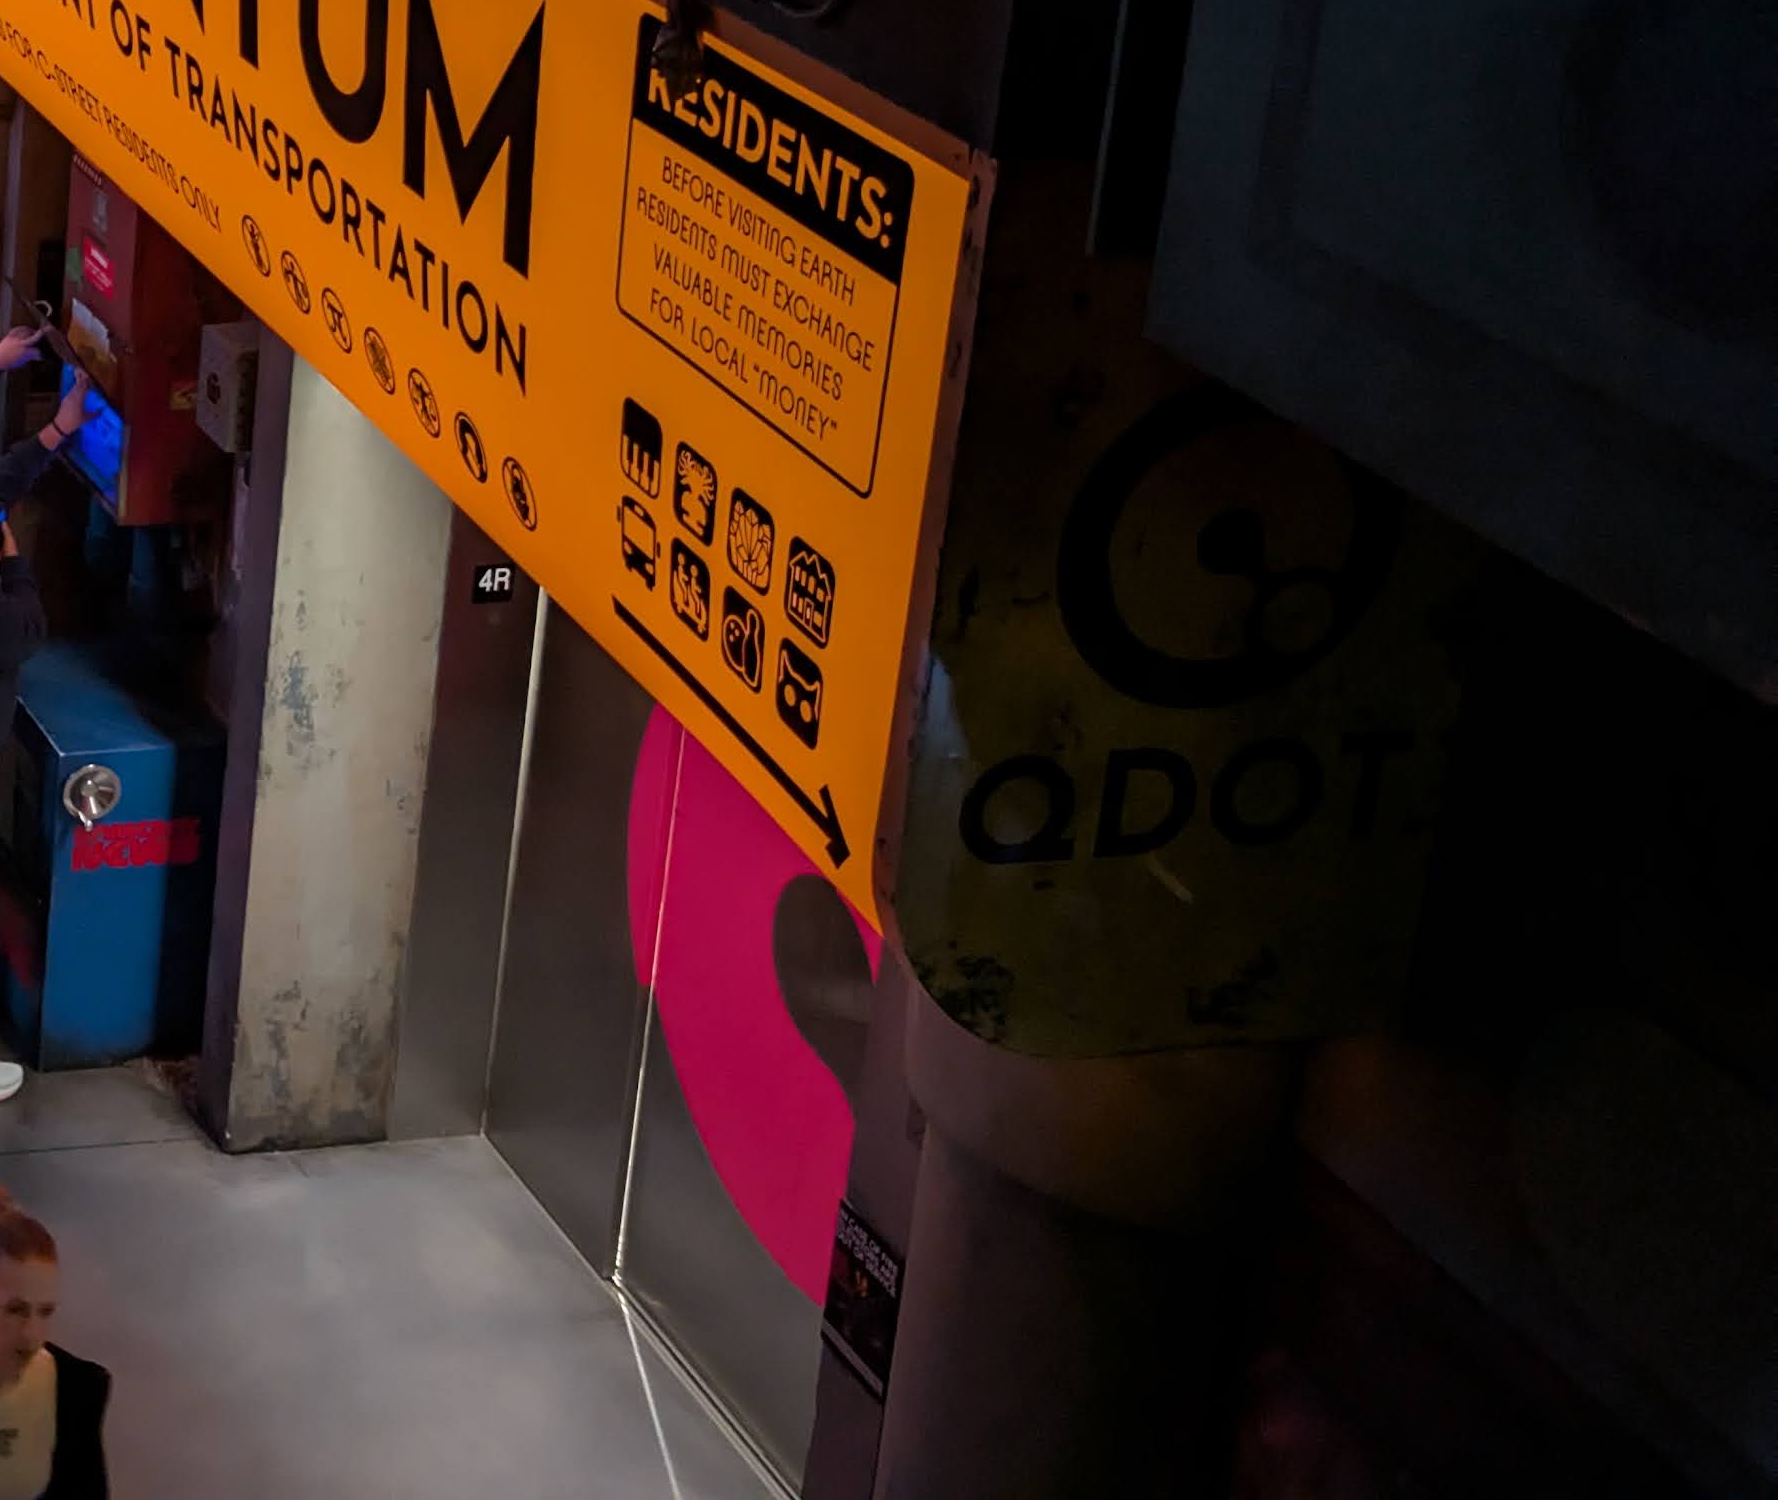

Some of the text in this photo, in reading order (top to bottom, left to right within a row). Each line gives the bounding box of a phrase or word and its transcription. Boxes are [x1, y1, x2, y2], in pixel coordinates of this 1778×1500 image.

[4, 18, 40, 69] FOR
[38, 49, 105, 124] C-STREET
[104, 106, 181, 196] RESIDENTS
[179, 174, 223, 234] ONLY
[647, 68, 894, 249] RESIDENTS:
[164, 32, 528, 398] TRANSPORTATION
[636, 187, 876, 373] RESIDENTS MUST EXCHANGE
[661, 155, 856, 307] BEFORE VISITING EARTH
[649, 288, 838, 442] FOR LOCAL "MONEY"
[653, 243, 844, 402] VALUABLE MEMORIES
[477, 565, 511, 593] 4R
